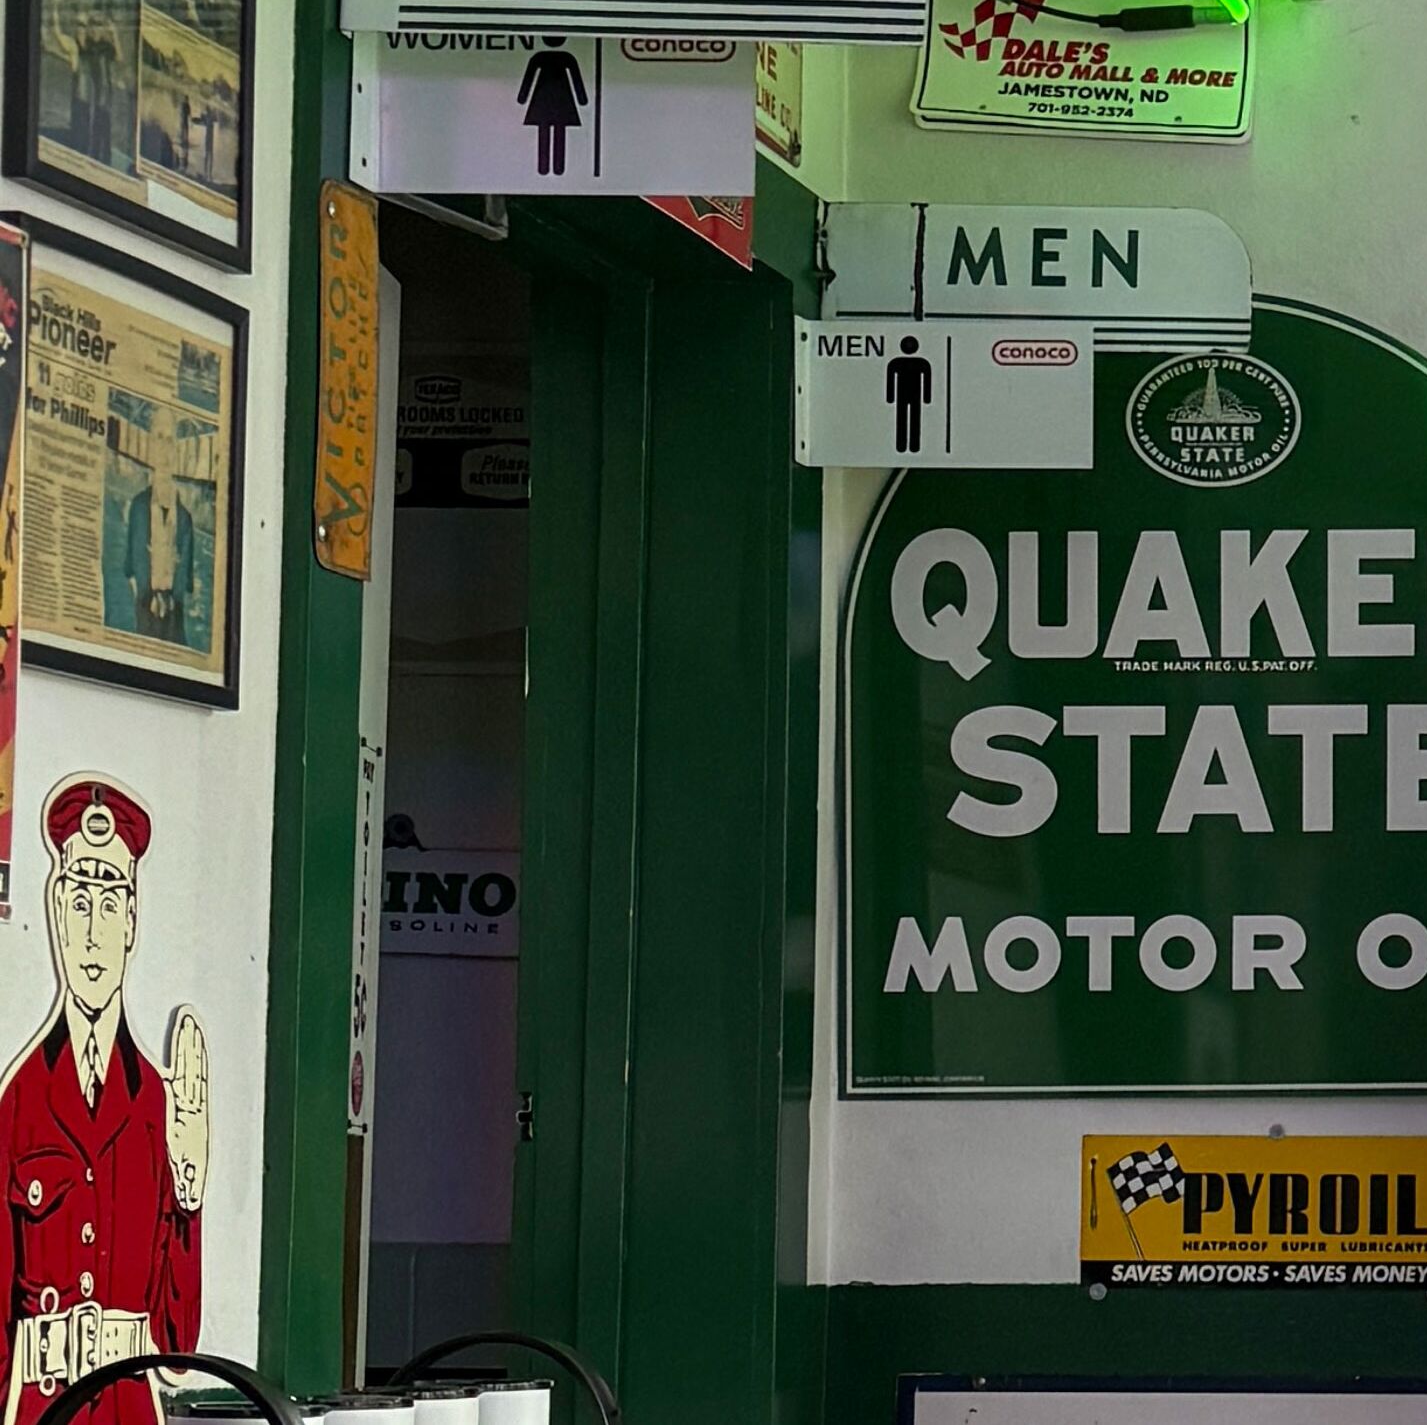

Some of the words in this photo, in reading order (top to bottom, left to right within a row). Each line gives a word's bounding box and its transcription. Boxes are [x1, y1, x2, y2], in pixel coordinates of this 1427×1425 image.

[999, 38, 1110, 65] DALE'S
[998, 61, 1066, 81] AUTO
[1068, 63, 1135, 83] MALL
[1139, 67, 1161, 85] &
[1164, 68, 1239, 89] MORE
[997, 81, 1135, 104] JAMESTOWN,
[1139, 87, 1170, 105] ND
[946, 225, 1140, 290] MEN
[28, 298, 118, 367] Pioneer
[817, 334, 886, 358] MEN
[998, 344, 1072, 362] conoco
[322, 222, 366, 528] VICTOR
[1221, 359, 1244, 373] PER
[51, 397, 106, 439] Phillips
[460, 406, 524, 423] LOCKED
[1170, 425, 1256, 444] QUAKER
[1180, 447, 1246, 464] STATE
[1227, 452, 1273, 478] MOTOR
[1271, 433, 1290, 454] OIL
[1114, 659, 1160, 673] TRADE
[1163, 659, 1202, 673] MARK
[1204, 659, 1236, 673] REG.
[882, 914, 1307, 995] MOTOR
[1181, 1239, 1269, 1253] HEATPROOF
[1280, 1240, 1328, 1253] SUPER
[1110, 1263, 1175, 1283] SAVES
[1177, 1264, 1270, 1284] MOTORS
[1284, 1264, 1348, 1284] SAVES
